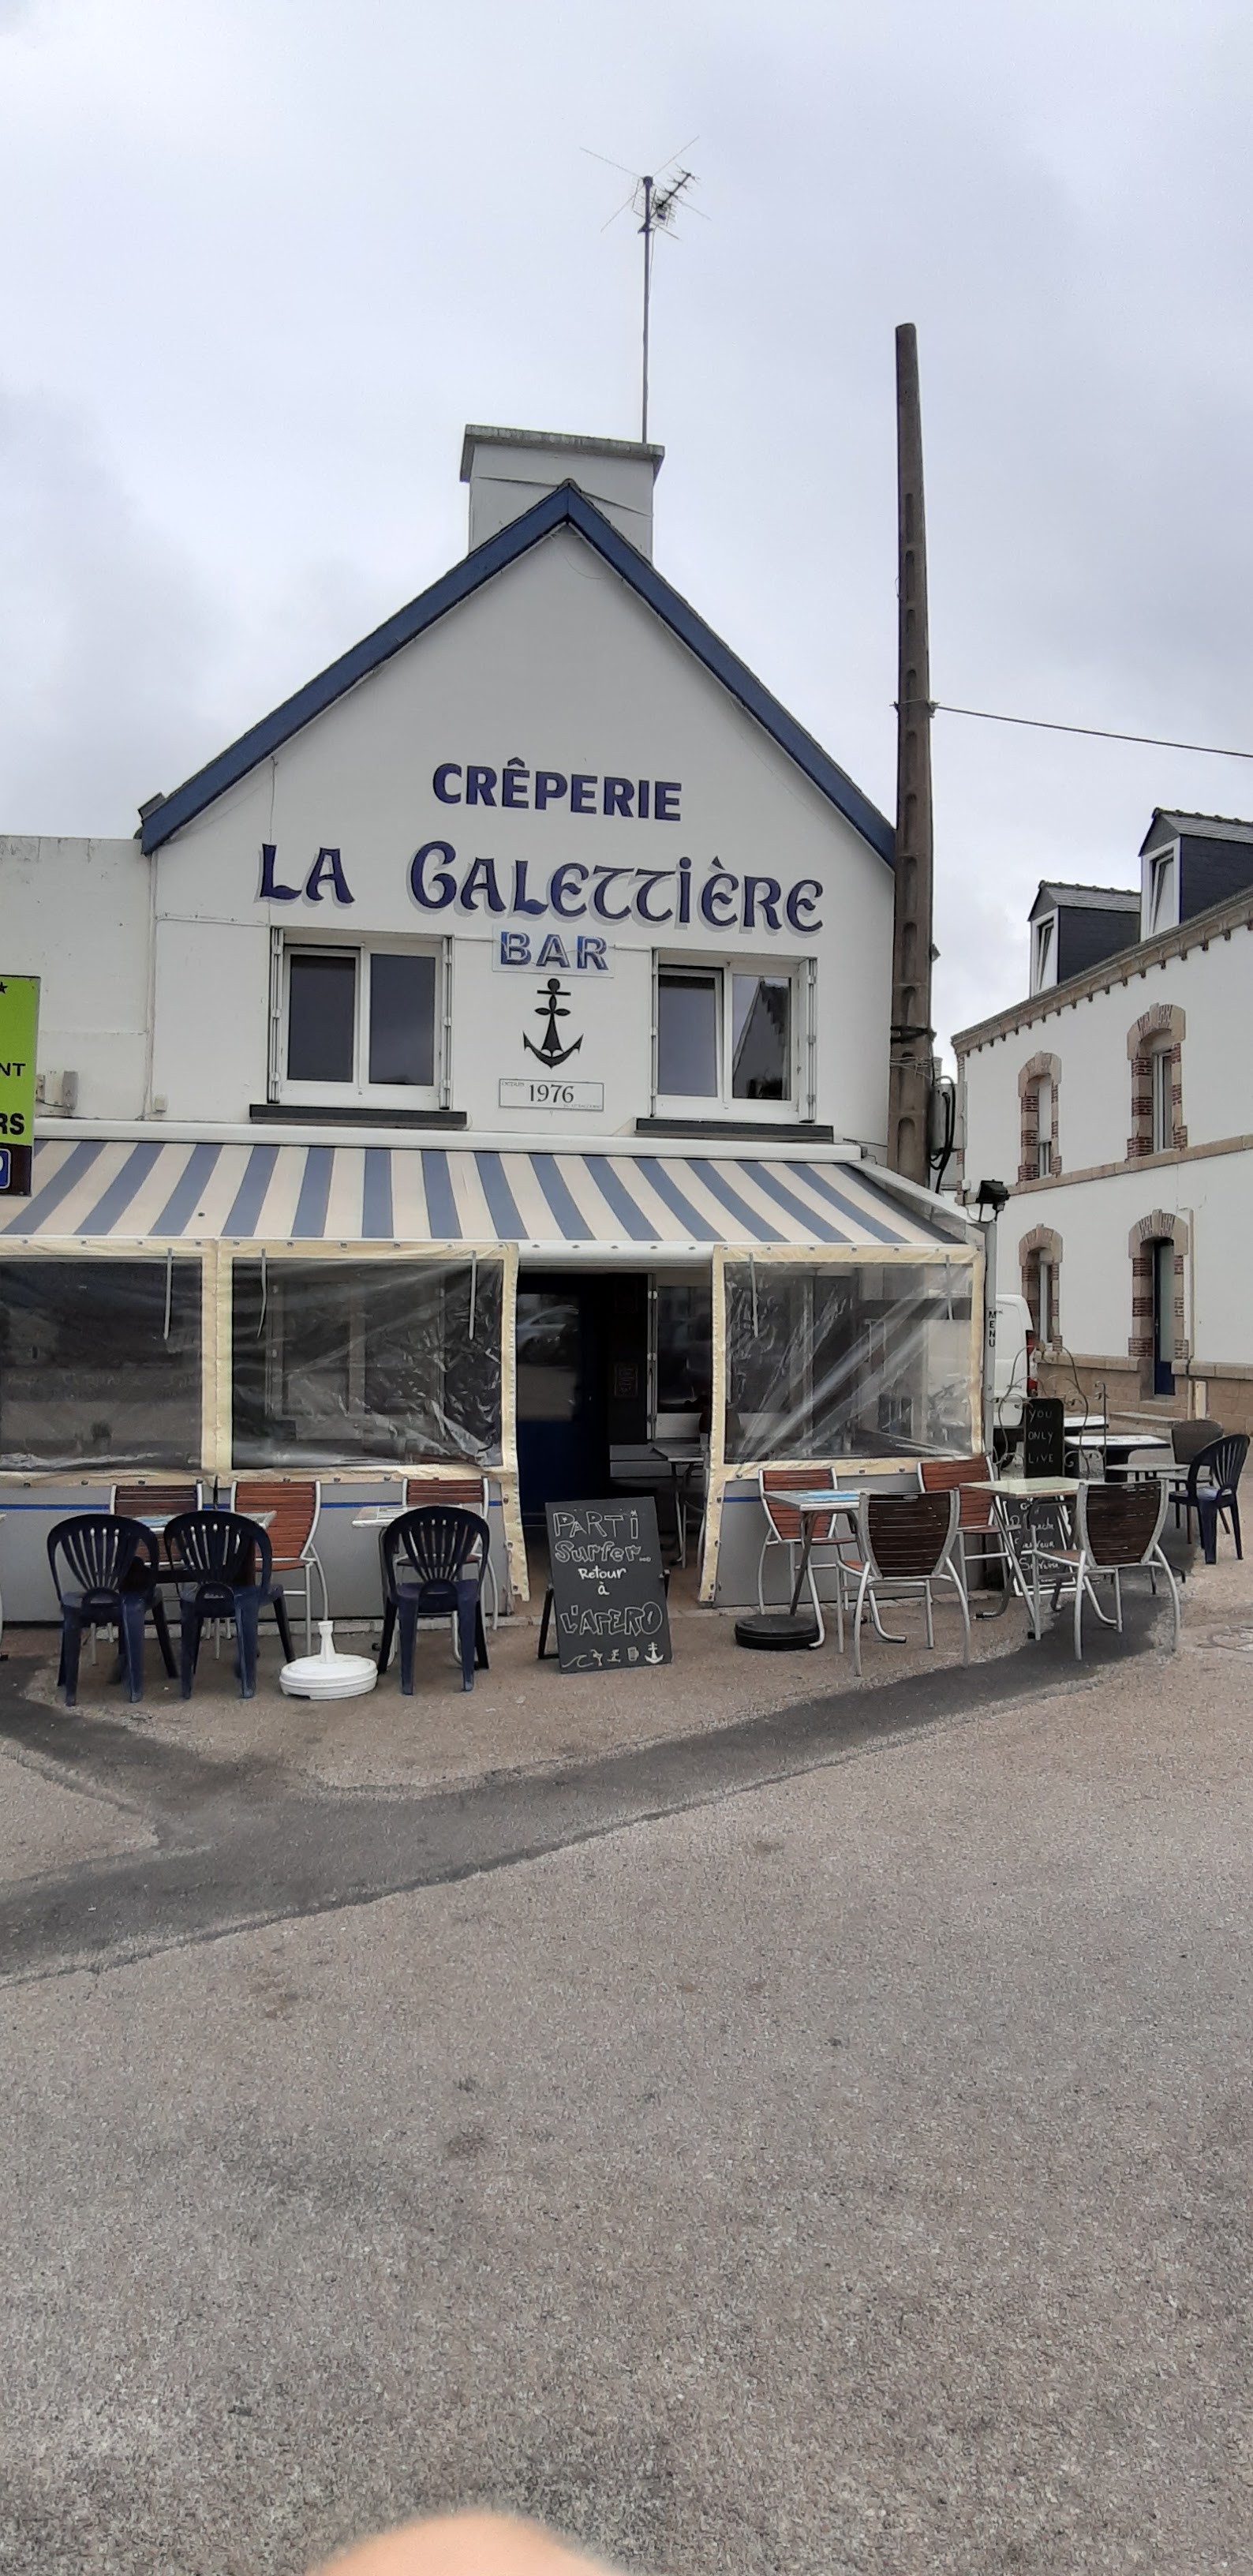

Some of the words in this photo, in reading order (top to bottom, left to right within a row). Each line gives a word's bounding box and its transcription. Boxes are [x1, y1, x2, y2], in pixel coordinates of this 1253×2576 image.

[432, 757, 682, 822] CRÊPERIE
[257, 843, 355, 905] LA
[500, 931, 609, 971] BAR
[529, 1084, 574, 1103] 1976
[1029, 1410, 1053, 1423] YOU
[1028, 1431, 1053, 1444] ONLY
[1028, 1453, 1053, 1464] LIVE
[553, 1511, 640, 1539] PARTI
[578, 1565, 627, 1579] Retour
[597, 1581, 610, 1595] à
